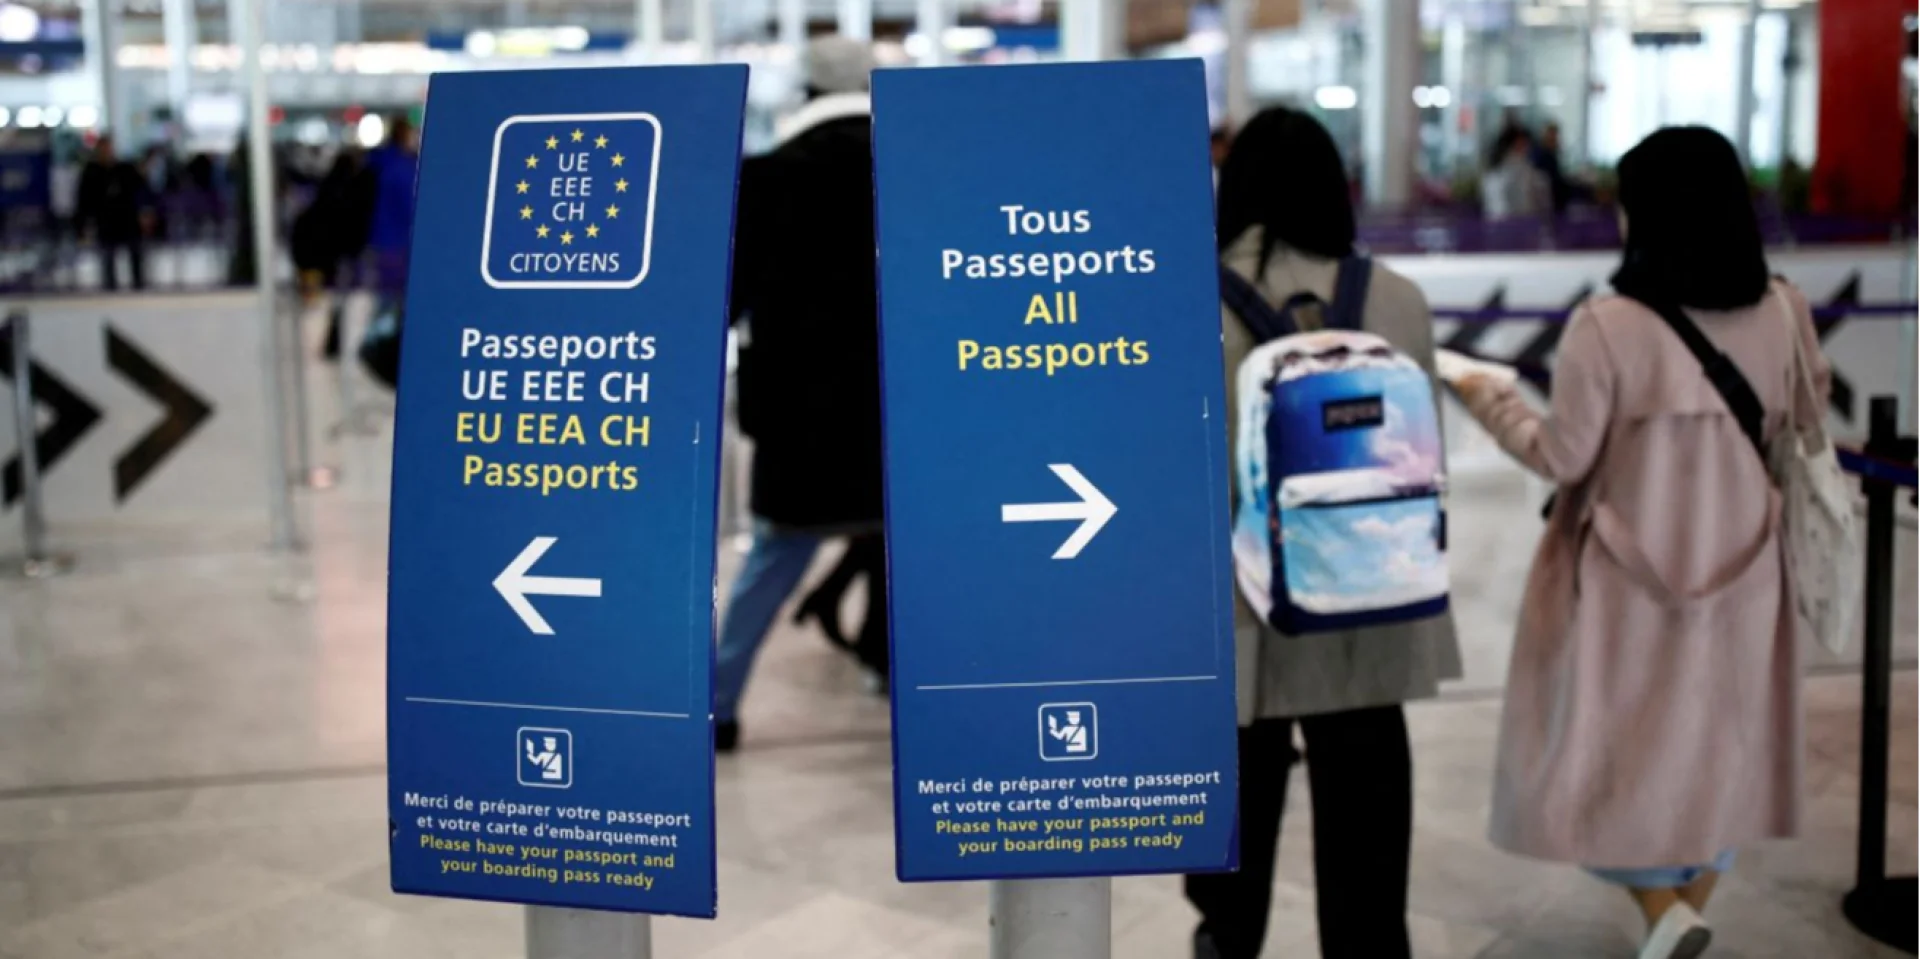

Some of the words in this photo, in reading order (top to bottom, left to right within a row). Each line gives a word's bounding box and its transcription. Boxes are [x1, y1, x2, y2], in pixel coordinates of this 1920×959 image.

[558, 152, 589, 172] UE
[550, 177, 592, 197] EEE
[552, 201, 585, 222] CH
[999, 205, 1091, 235] Tous
[510, 252, 620, 273] CITOYENS
[941, 245, 1156, 284] Passeports
[1024, 291, 1078, 325] All
[461, 327, 656, 367] Passeports
[957, 336, 1150, 376] Passports
[462, 370, 508, 401] UE
[522, 370, 585, 402] EEE
[599, 371, 649, 403] CH
[456, 412, 502, 444] EU
[516, 412, 586, 445] EEA
[599, 414, 650, 447] CH
[464, 455, 638, 496] Passports
[918, 778, 966, 794] Merci
[972, 778, 993, 792] de
[1000, 776, 1076, 795] préparer
[1082, 775, 1128, 788] votre
[1134, 771, 1220, 790] passeport
[404, 792, 448, 809] Merci
[453, 796, 473, 811] de
[480, 799, 551, 817] préparer
[556, 806, 600, 820] votre
[607, 809, 691, 828] passeport
[932, 801, 950, 814] et
[955, 799, 1001, 813] votre
[1007, 798, 1051, 812] carte
[416, 815, 432, 829] et
[438, 818, 481, 833] votre
[486, 821, 528, 836] carte
[936, 819, 990, 834] Please
[996, 817, 1038, 832] have
[1044, 818, 1084, 834] your
[1090, 813, 1167, 832] passport
[1172, 810, 1204, 826] and
[420, 834, 470, 852] Please
[476, 838, 514, 855] have
[521, 844, 558, 860] your
[564, 848, 637, 867] passport
[643, 852, 674, 869] and
[959, 841, 998, 857] your
[1004, 835, 1083, 853] boarding
[1090, 837, 1128, 852] pass
[1133, 831, 1183, 849] ready
[441, 860, 477, 874] your
[483, 860, 558, 884] boarding
[564, 869, 600, 883] pass
[606, 871, 654, 891] ready
